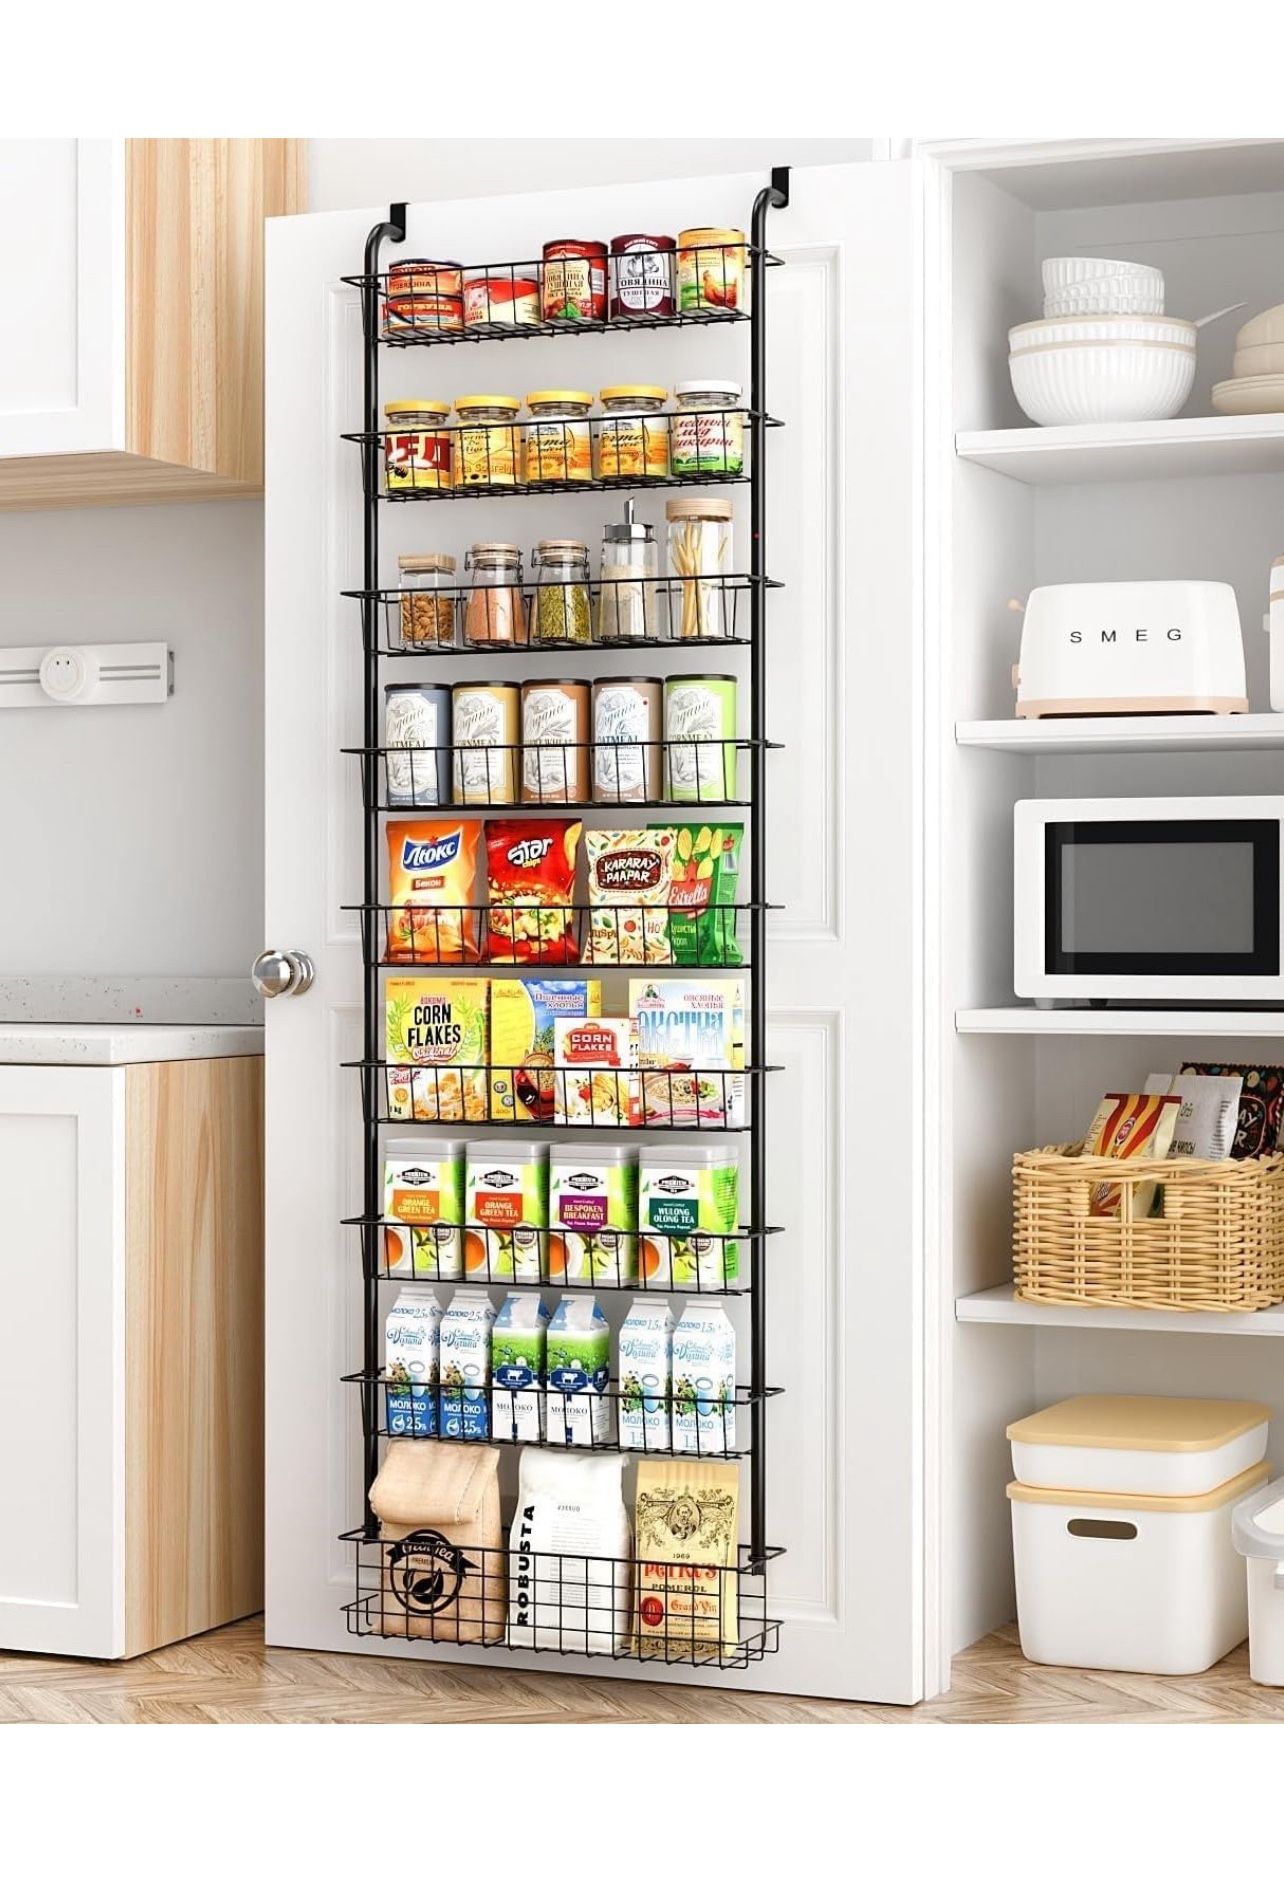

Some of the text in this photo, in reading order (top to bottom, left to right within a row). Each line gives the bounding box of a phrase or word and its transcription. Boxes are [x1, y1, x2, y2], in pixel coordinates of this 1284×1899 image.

[1069, 628, 1183, 644] SMEG
[404, 841, 457, 867] Люкс
[603, 857, 659, 874] KARARAY
[414, 1003, 452, 1026] CORN
[407, 1024, 462, 1047] FLAKES
[571, 1034, 612, 1044] CORN
[571, 1043, 612, 1052] FLAKES
[484, 1201, 513, 1209] ORANGE
[479, 1208, 519, 1217] GREEN TEA
[563, 1212, 605, 1221] BREAKFAST
[658, 1207, 690, 1216] WULONG
[653, 1215, 695, 1225] OLONG TEA
[389, 1400, 427, 1411] МОЛОКО
[444, 1402, 481, 1414] МОЛОКО
[496, 1401, 533, 1412] МООКО
[516, 1505, 536, 1626] ROBUSTA
